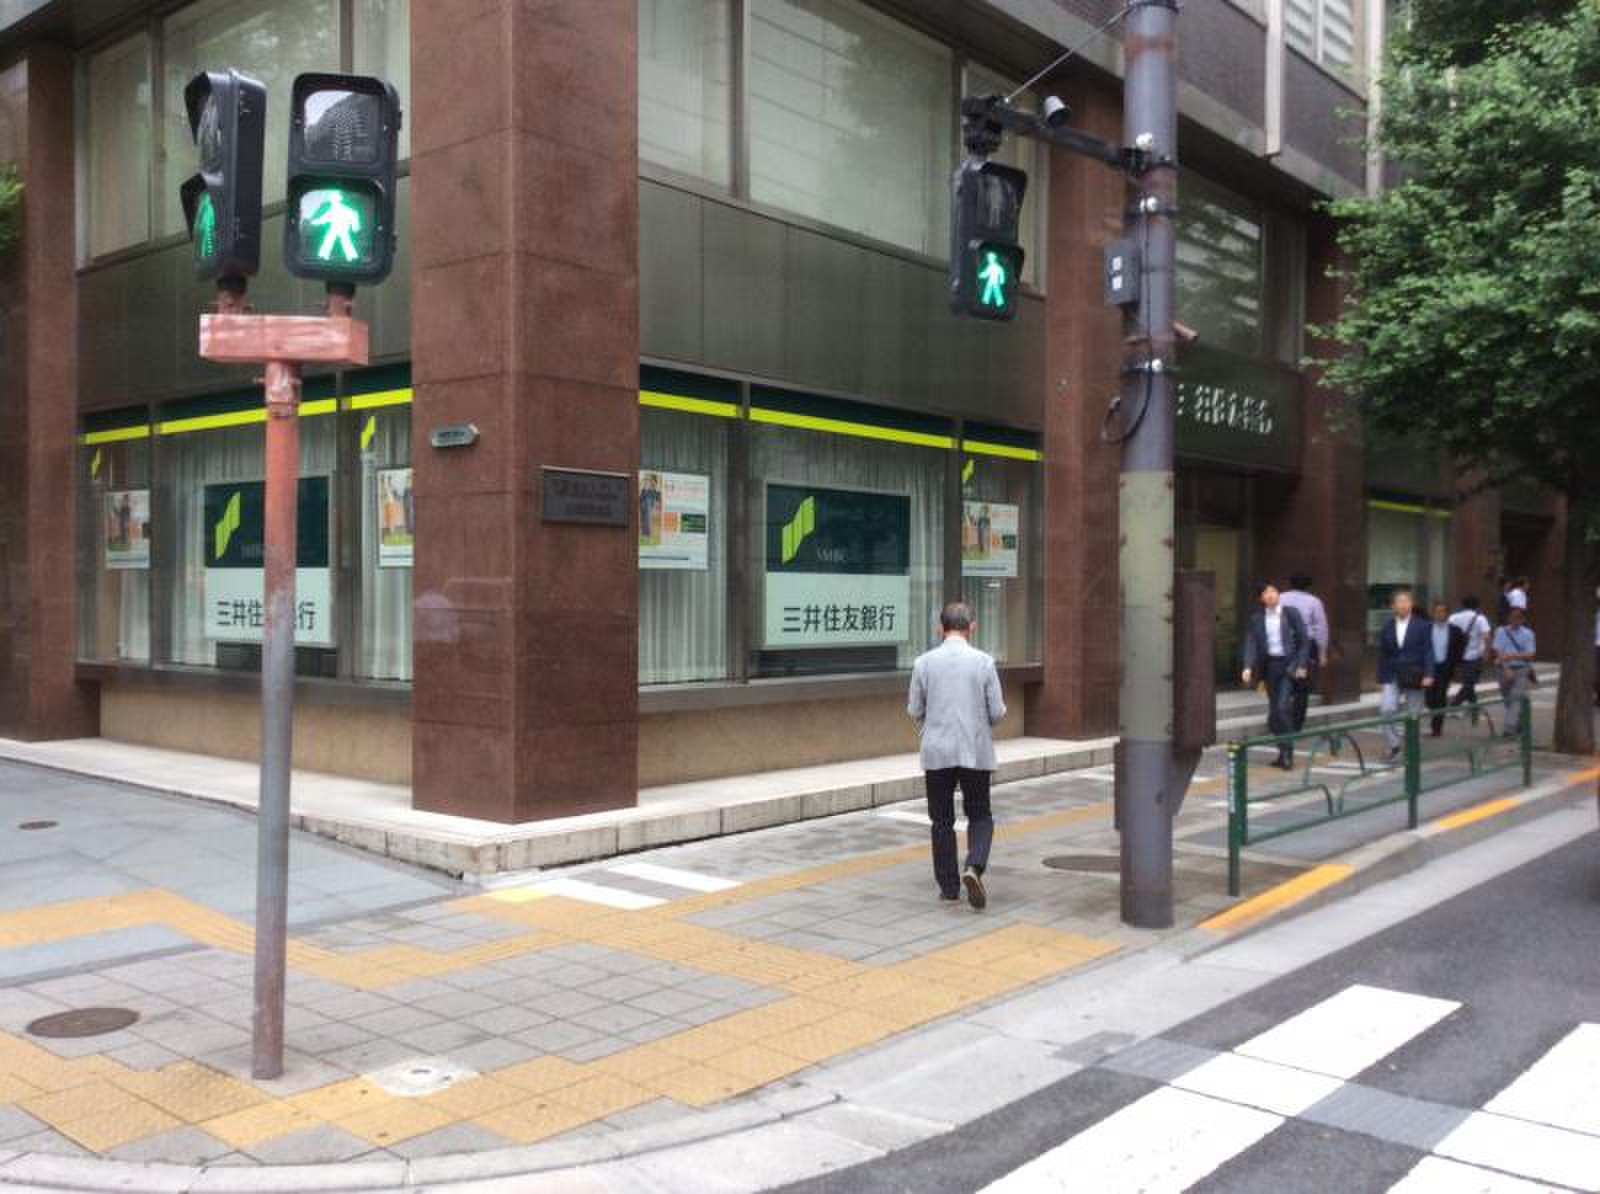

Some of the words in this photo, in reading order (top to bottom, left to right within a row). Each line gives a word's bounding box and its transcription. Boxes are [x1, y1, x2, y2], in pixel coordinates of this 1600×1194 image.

[217, 599, 316, 630] 三井住行
[782, 603, 896, 633] 三井住友銀行
